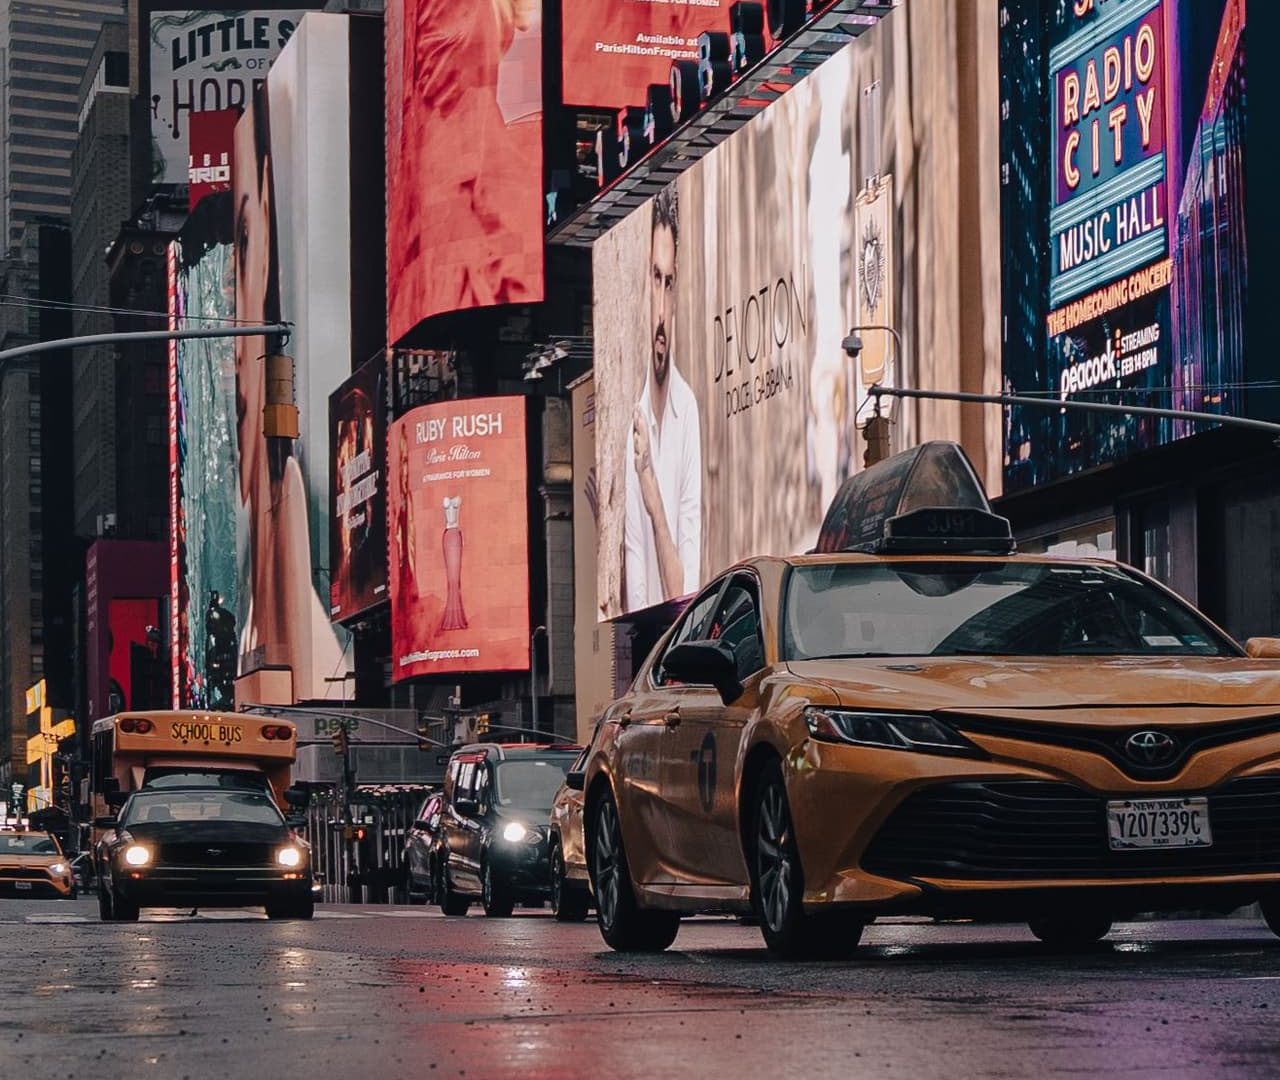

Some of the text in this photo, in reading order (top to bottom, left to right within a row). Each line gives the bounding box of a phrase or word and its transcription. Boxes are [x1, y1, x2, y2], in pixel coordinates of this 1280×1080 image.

[172, 17, 269, 71] LITTLE
[635, 32, 686, 46] Available
[246, 58, 265, 70] OF
[1063, 23, 1156, 128] RADIO
[1063, 86, 1156, 190] CITY
[1059, 185, 1164, 272] MUSIC HALL
[1120, 322, 1160, 354] STREAMING
[1060, 338, 1116, 414] peacock
[415, 412, 503, 444] RUBY RUSH
[447, 443, 482, 463] Hilton
[171, 723, 242, 742] SCHOOL BUS
[1132, 800, 1185, 811] NEW YORK
[1116, 809, 1202, 839] Y207339C
